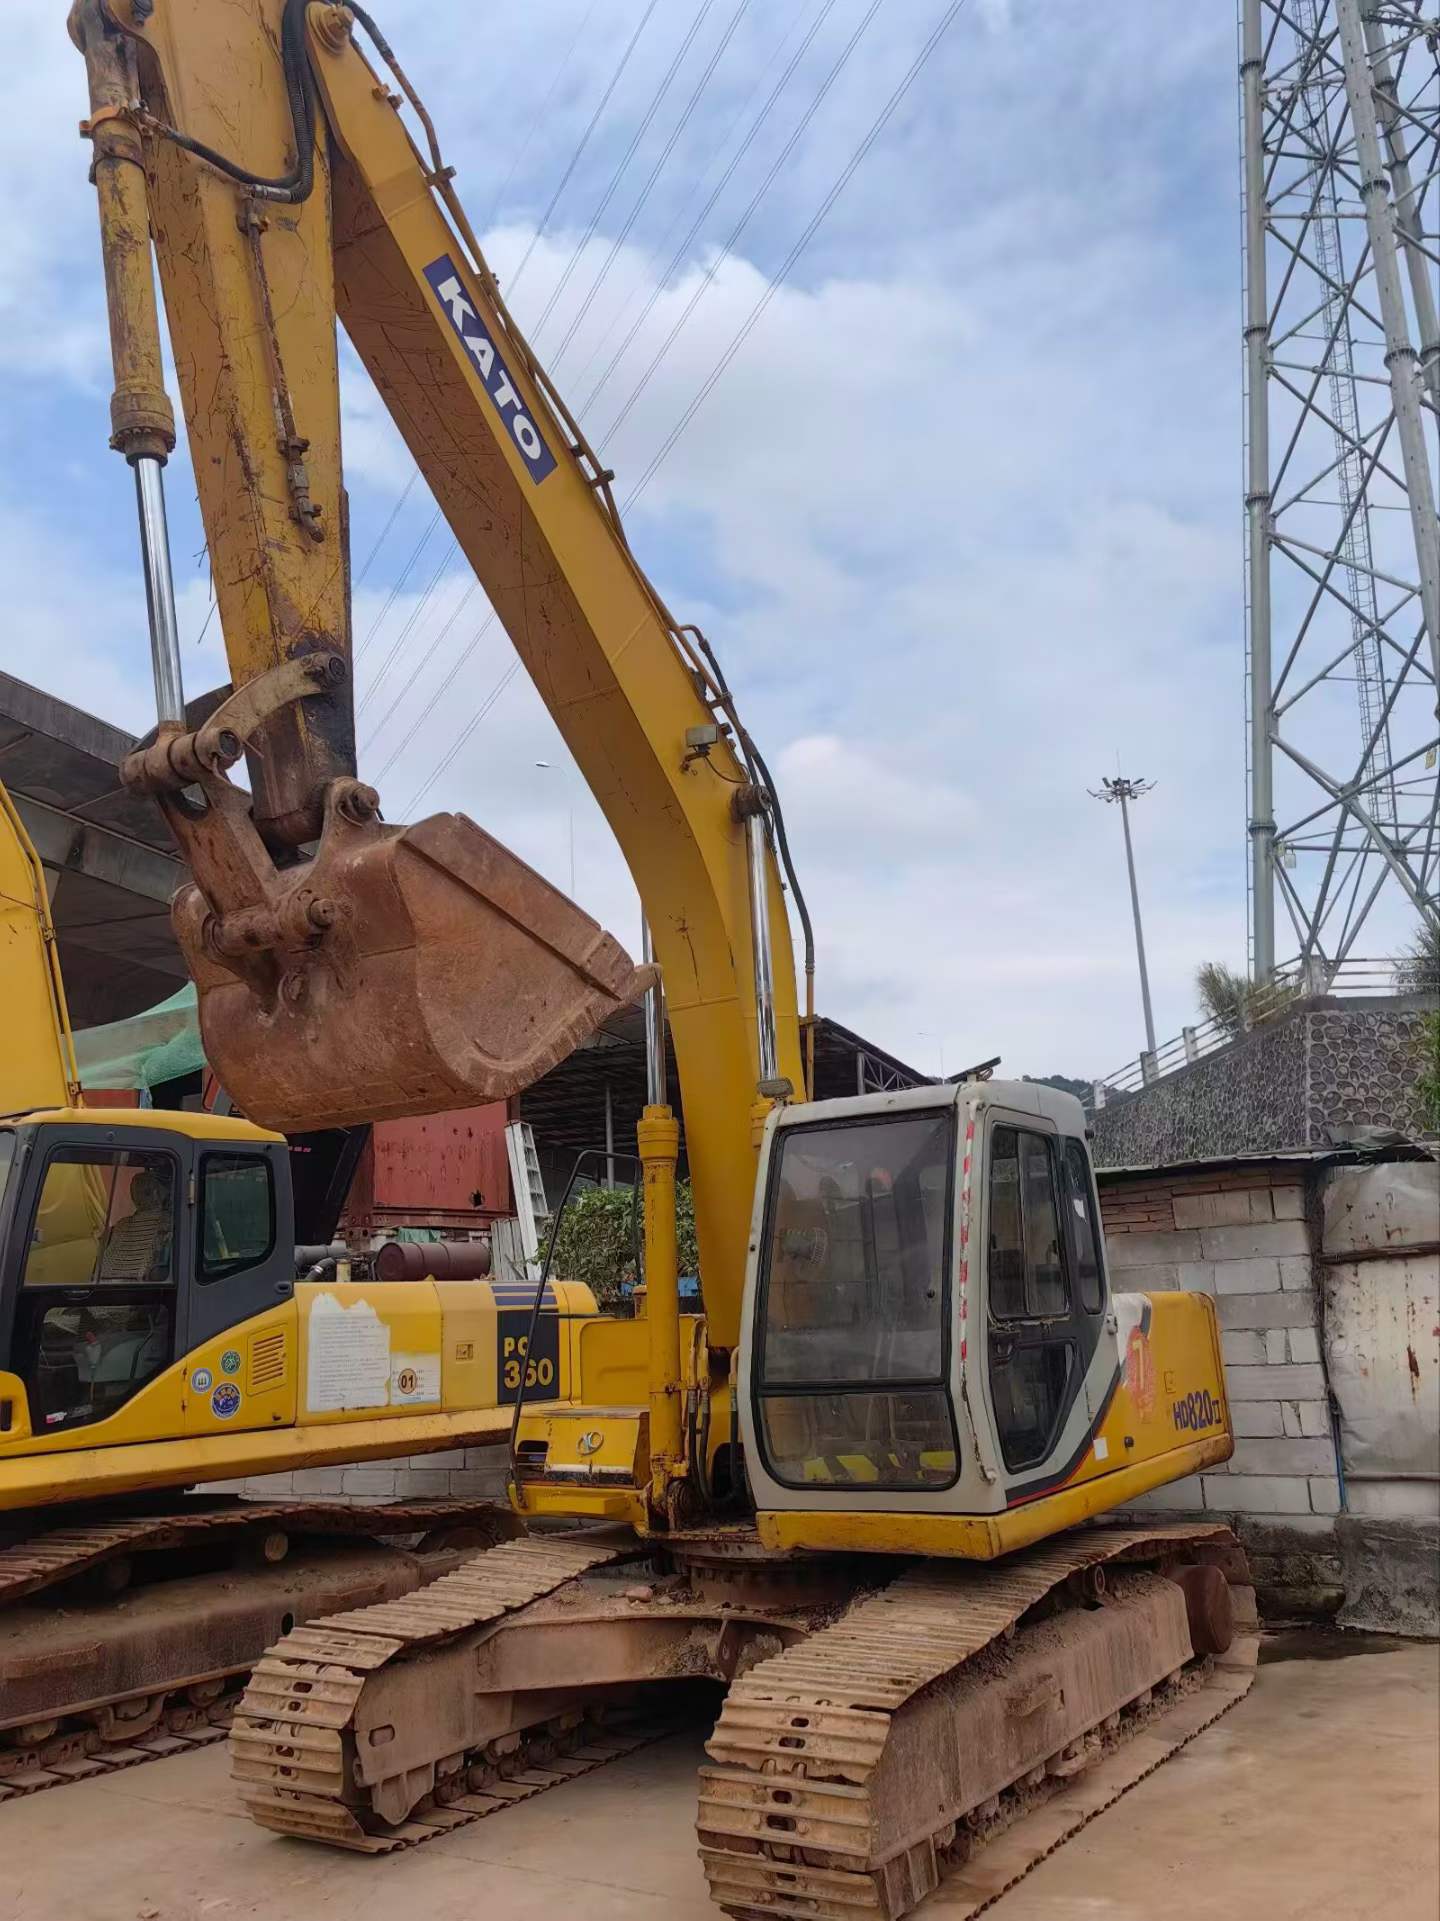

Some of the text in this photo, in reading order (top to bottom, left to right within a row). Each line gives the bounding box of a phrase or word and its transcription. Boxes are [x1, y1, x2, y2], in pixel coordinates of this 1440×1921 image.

[437, 275, 541, 460] KATO
[400, 1374, 414, 1389] 01
[503, 1357, 554, 1389] 360
